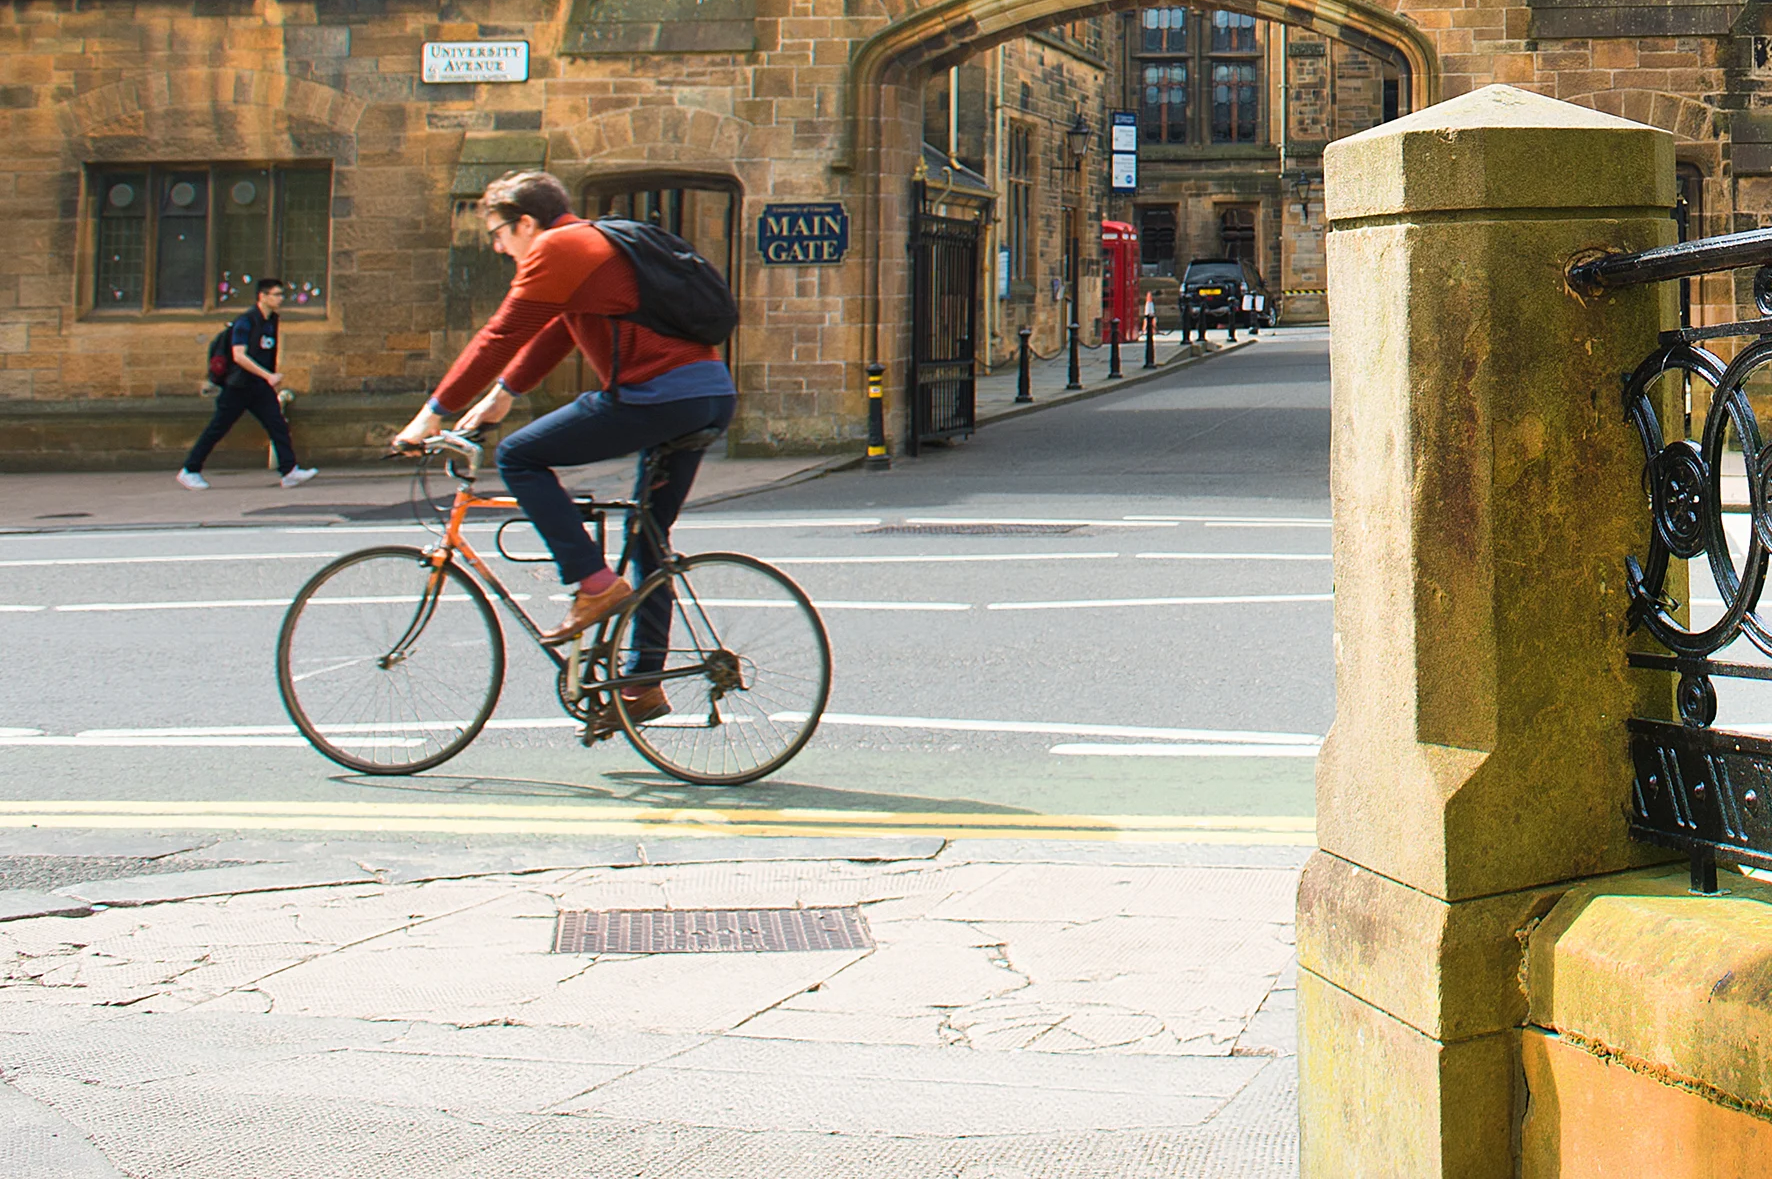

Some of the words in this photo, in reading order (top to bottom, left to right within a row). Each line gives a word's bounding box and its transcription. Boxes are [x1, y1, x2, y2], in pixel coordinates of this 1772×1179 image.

[430, 45, 523, 58] UNIVERSITY
[444, 59, 506, 72] AVENUE
[766, 215, 842, 236] MAIN
[768, 240, 838, 261] GATE
